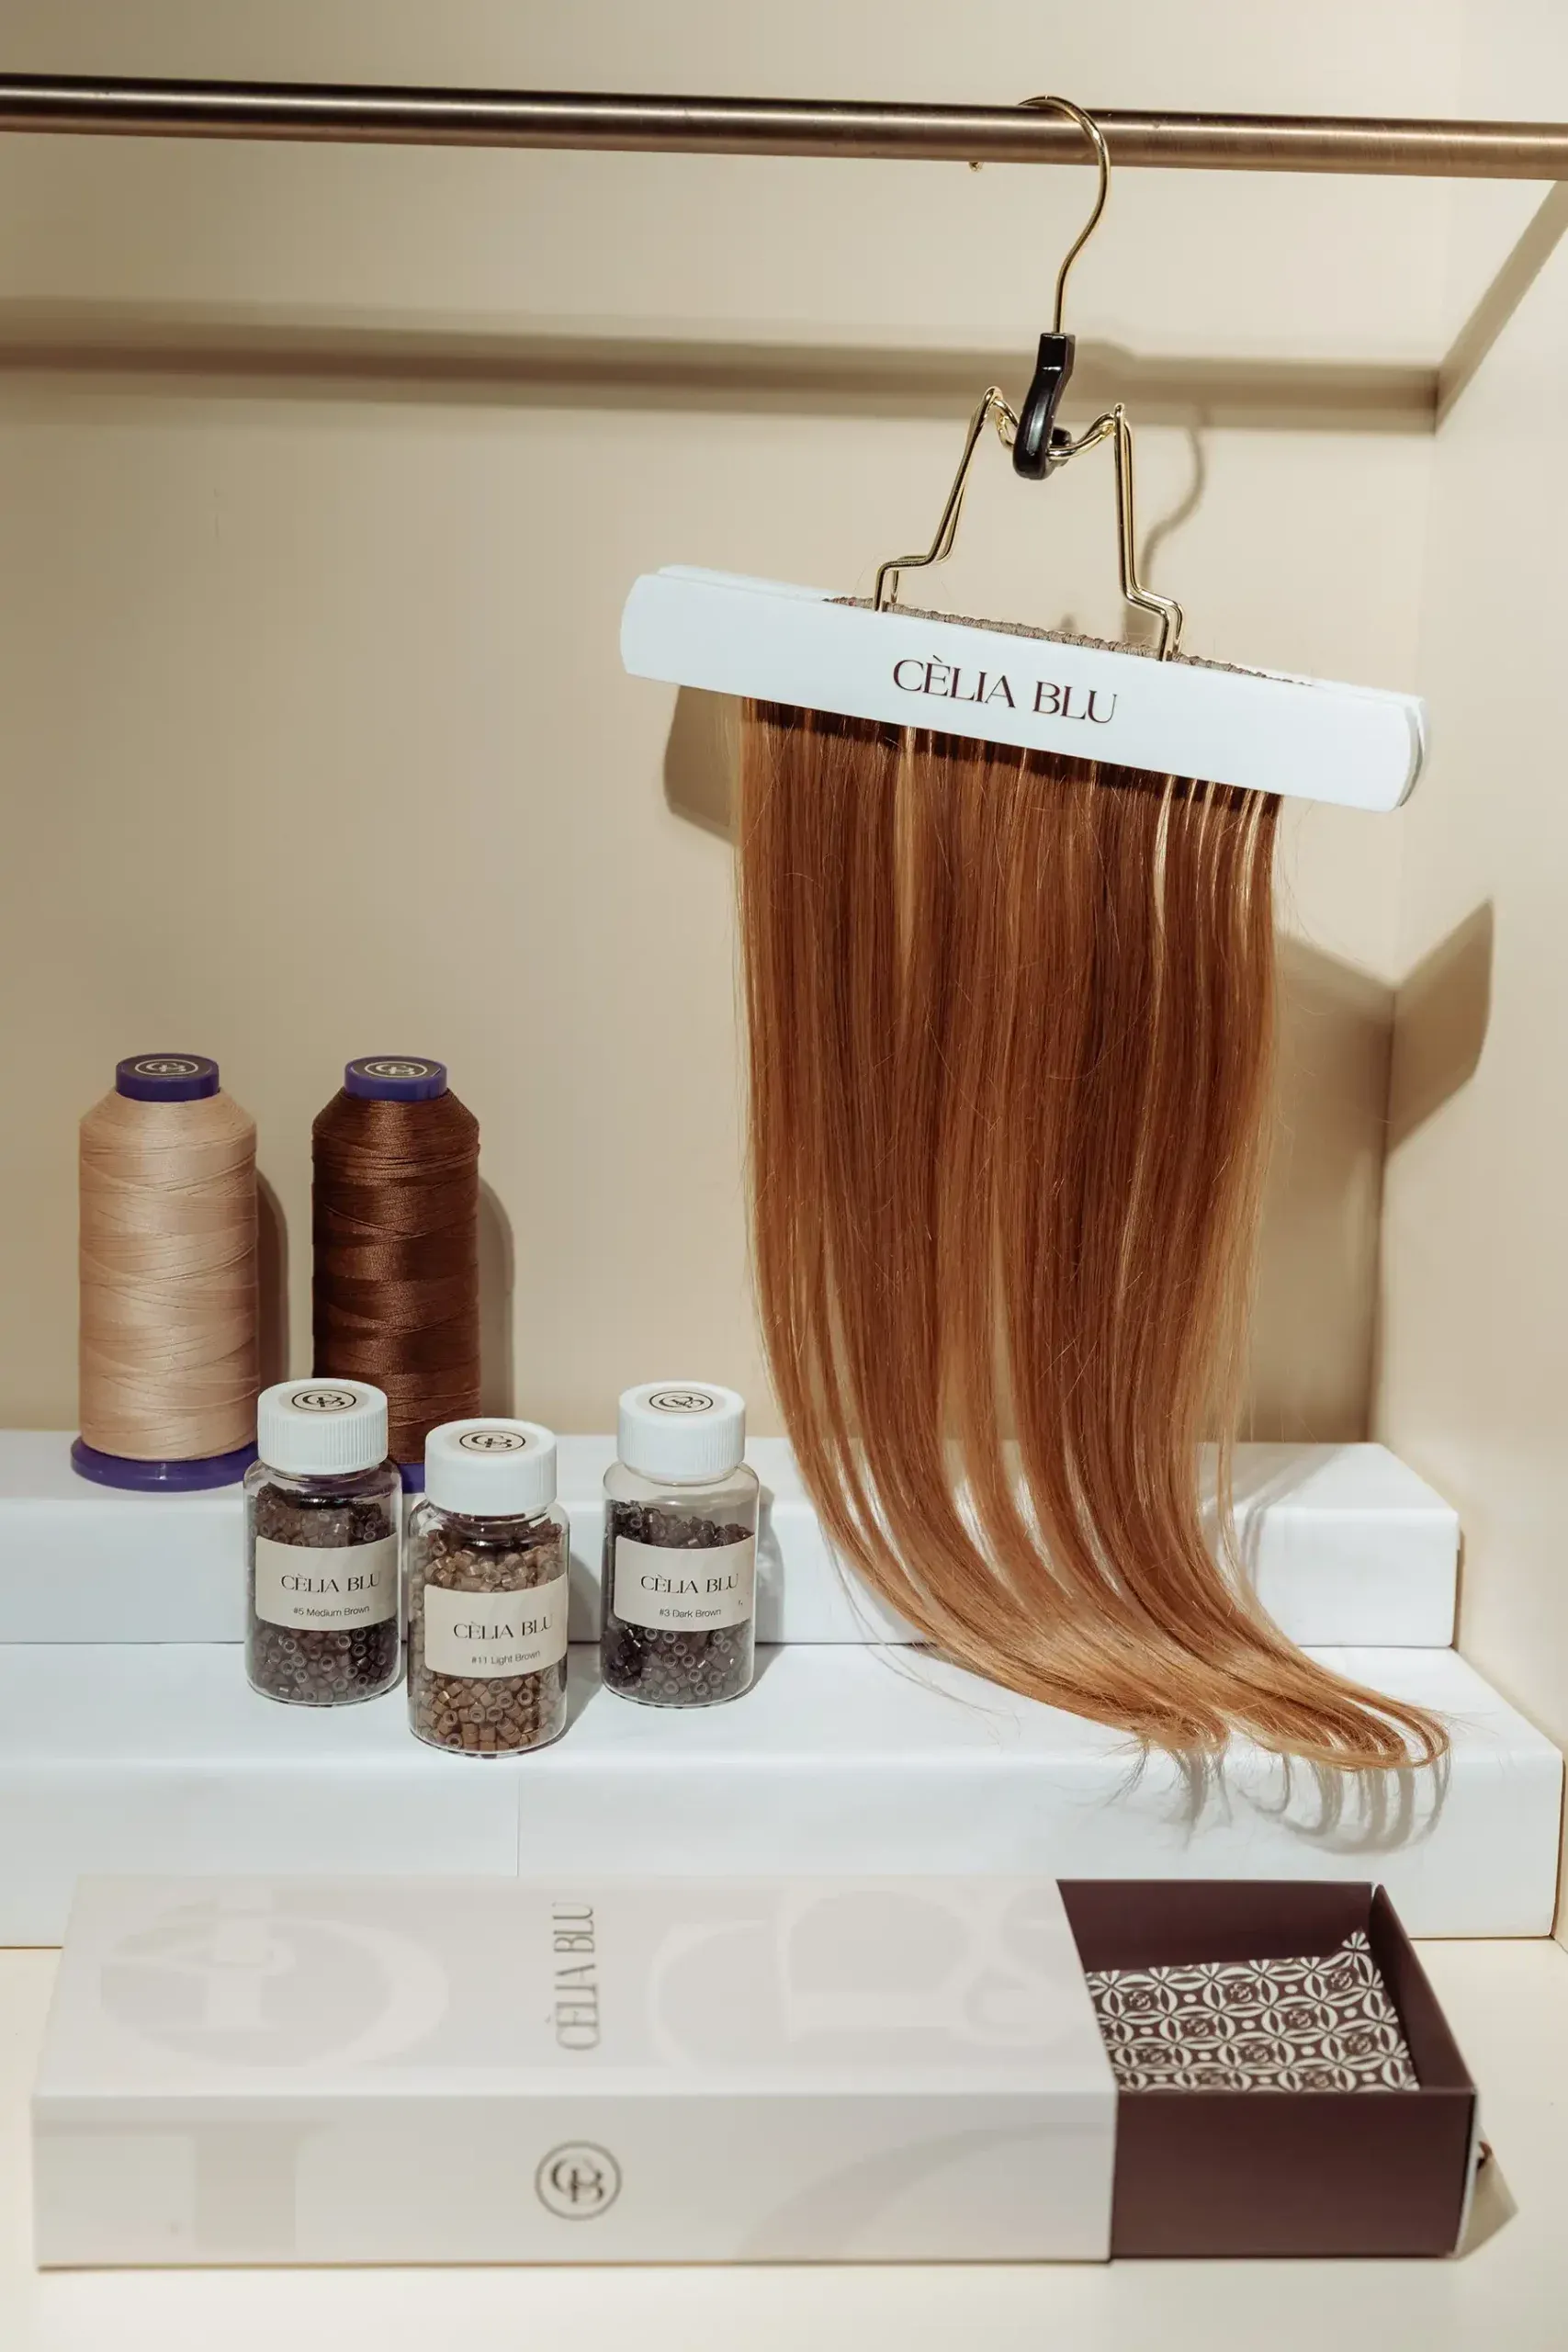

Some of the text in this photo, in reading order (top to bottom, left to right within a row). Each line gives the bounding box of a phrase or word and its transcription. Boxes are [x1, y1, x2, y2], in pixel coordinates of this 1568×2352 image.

[893, 654, 1118, 724] CÈLIA BLU
[280, 1571, 381, 1593] CÈLIA BLU
[640, 1572, 739, 1594] CÈLIA BLU
[293, 1605, 370, 1618] #5 Medium Brown
[659, 1608, 722, 1618] #3 Dark Brown
[453, 1613, 553, 1640] CÈLIA BLU
[471, 1650, 541, 1666] #11 Light Brown
[545, 1901, 602, 2051] CÈLIA BLU
